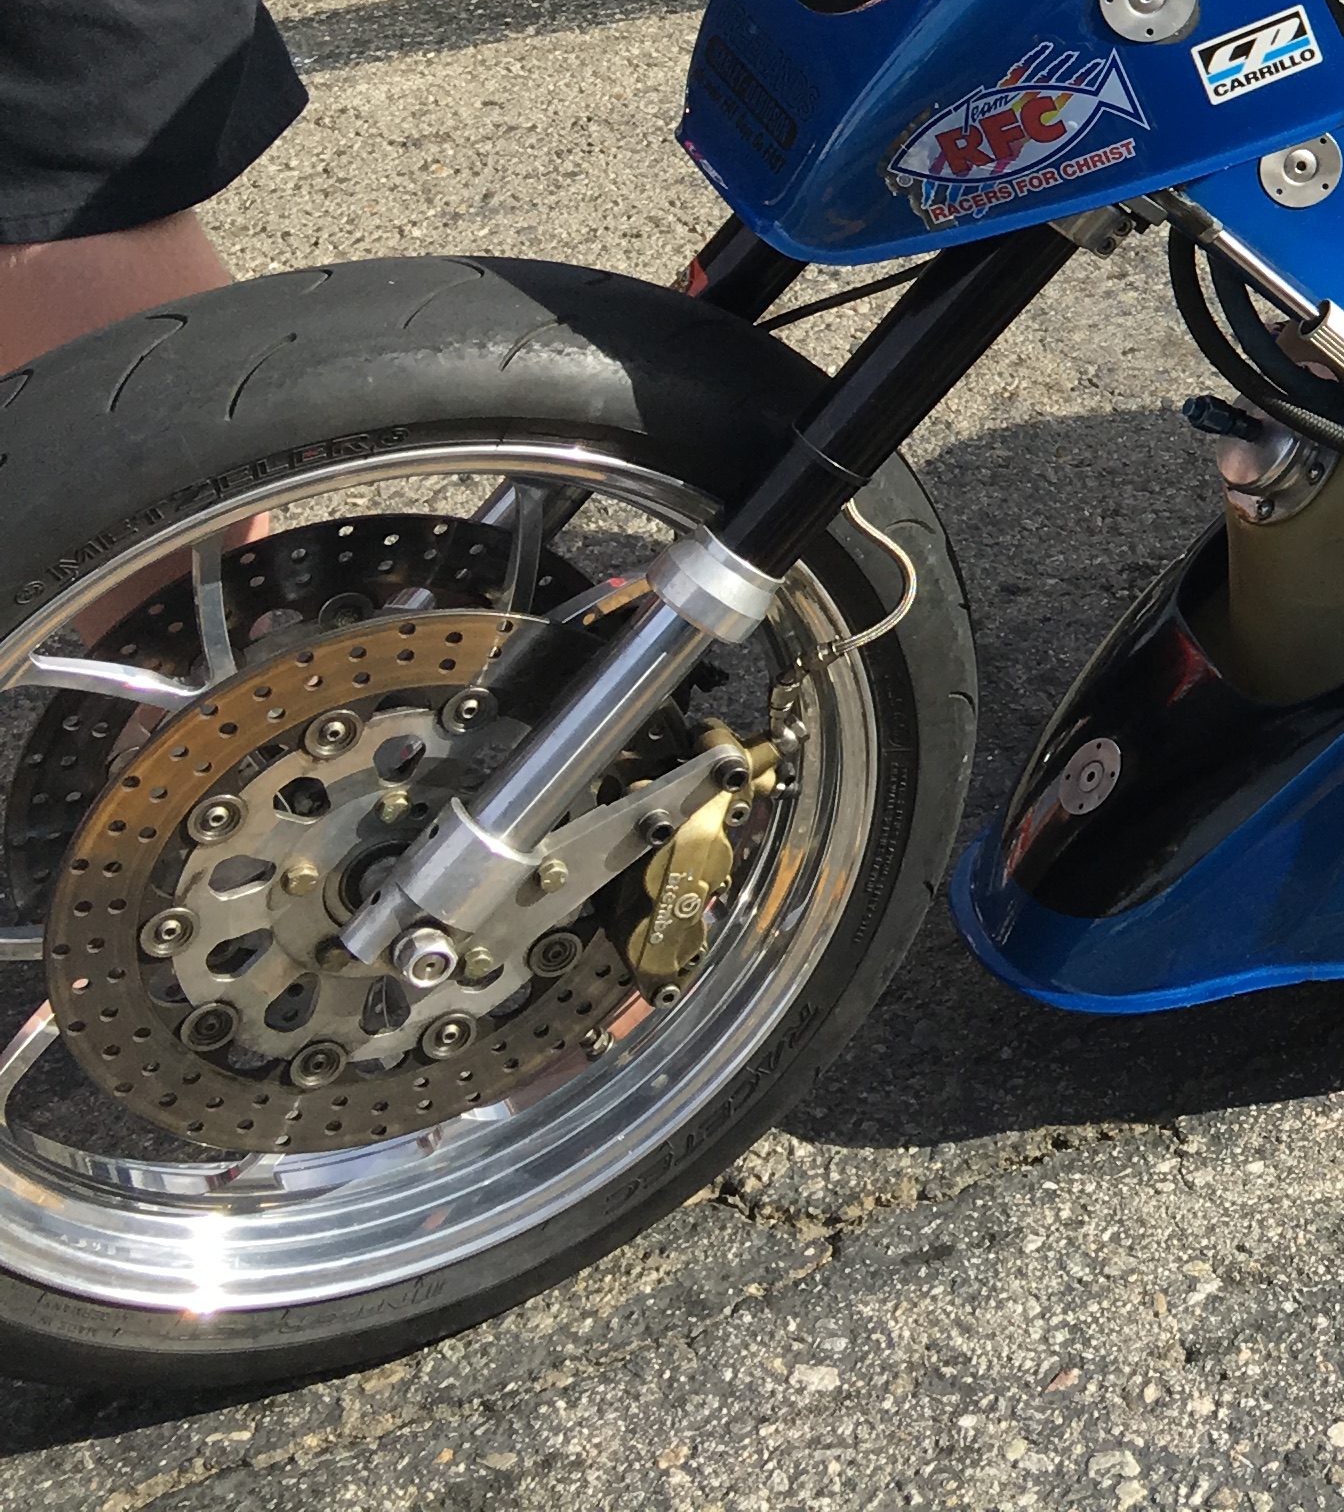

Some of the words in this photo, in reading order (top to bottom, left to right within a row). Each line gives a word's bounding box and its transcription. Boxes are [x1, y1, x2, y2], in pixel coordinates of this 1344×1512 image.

[1212, 47, 1316, 98] CARRILLO
[935, 96, 1068, 178] RFC
[953, 87, 1021, 135] Team
[930, 181, 1014, 223] RACERS
[1015, 167, 1061, 197] FOR
[1061, 139, 1135, 181] CHRIST
